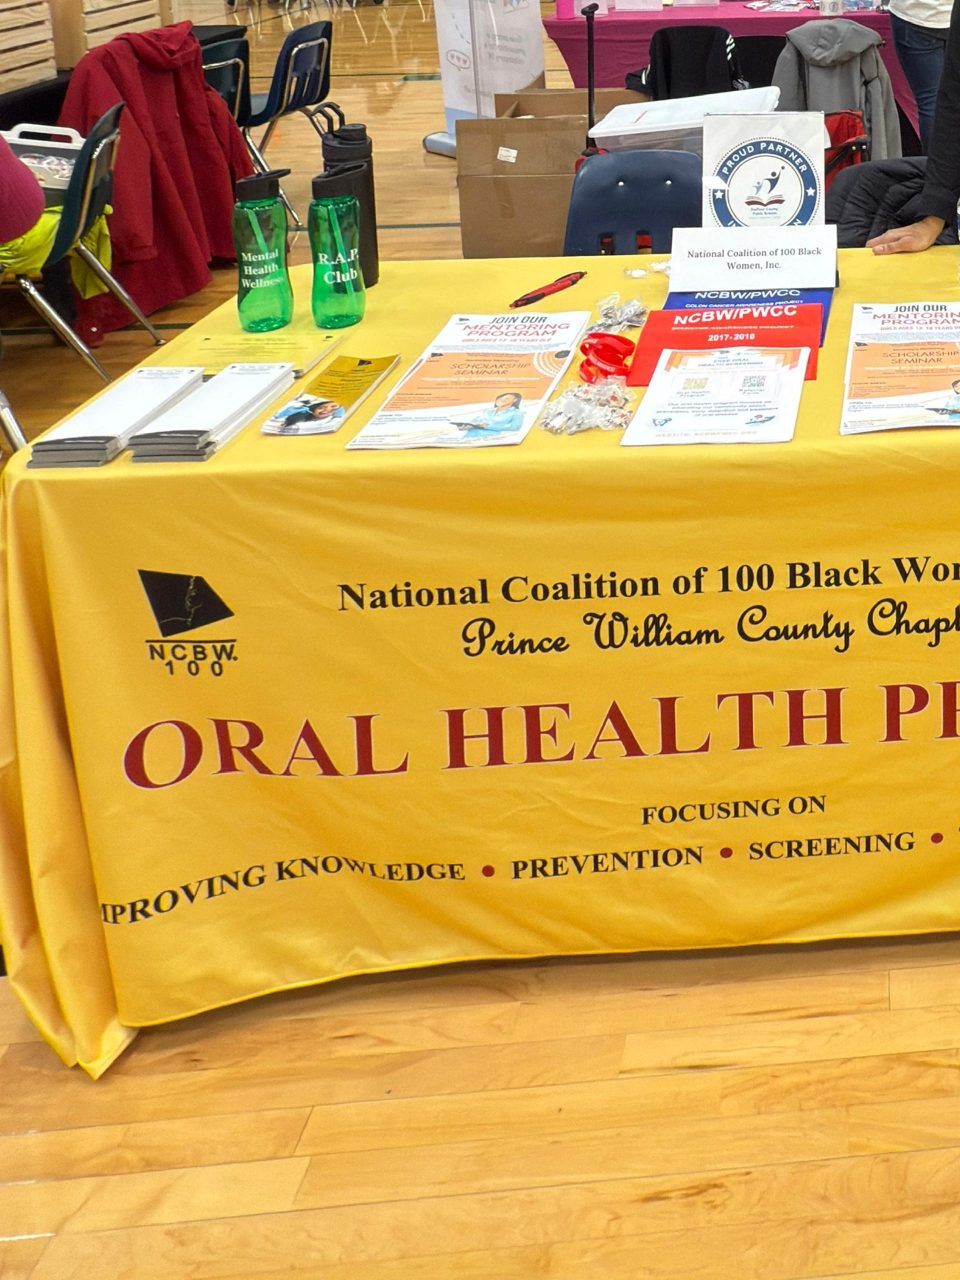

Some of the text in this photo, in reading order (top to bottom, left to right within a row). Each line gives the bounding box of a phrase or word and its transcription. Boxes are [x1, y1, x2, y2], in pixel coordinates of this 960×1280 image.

[721, 141, 808, 176] PROUD PARTNER
[242, 249, 279, 262] Mental
[687, 247, 822, 258] National Coalition of 100 Black
[244, 263, 279, 276] Health
[727, 261, 781, 271] Women, Inc.
[324, 268, 358, 285] Club
[695, 289, 801, 300] NCBW/PWCC
[674, 305, 797, 325] NCBW/PWCC
[894, 304, 947, 312] JOIN OUR
[463, 323, 570, 331] MENTORING
[490, 316, 519, 324] JOIN
[337, 578, 490, 612] National
[501, 570, 665, 604] Coalition
[672, 565, 710, 596] of
[717, 562, 774, 593] 100
[787, 557, 882, 590] Black
[461, 617, 569, 658] Prince
[583, 610, 725, 651] William
[737, 604, 855, 654] County
[165, 660, 224, 677] 100
[122, 713, 410, 791] ORAL
[440, 686, 849, 772] HEALTH
[641, 794, 827, 826] FOCUSING ON
[275, 854, 466, 882] KNOWLEDGE
[511, 844, 704, 880] PREVENTION
[748, 830, 917, 861] SCREENING
